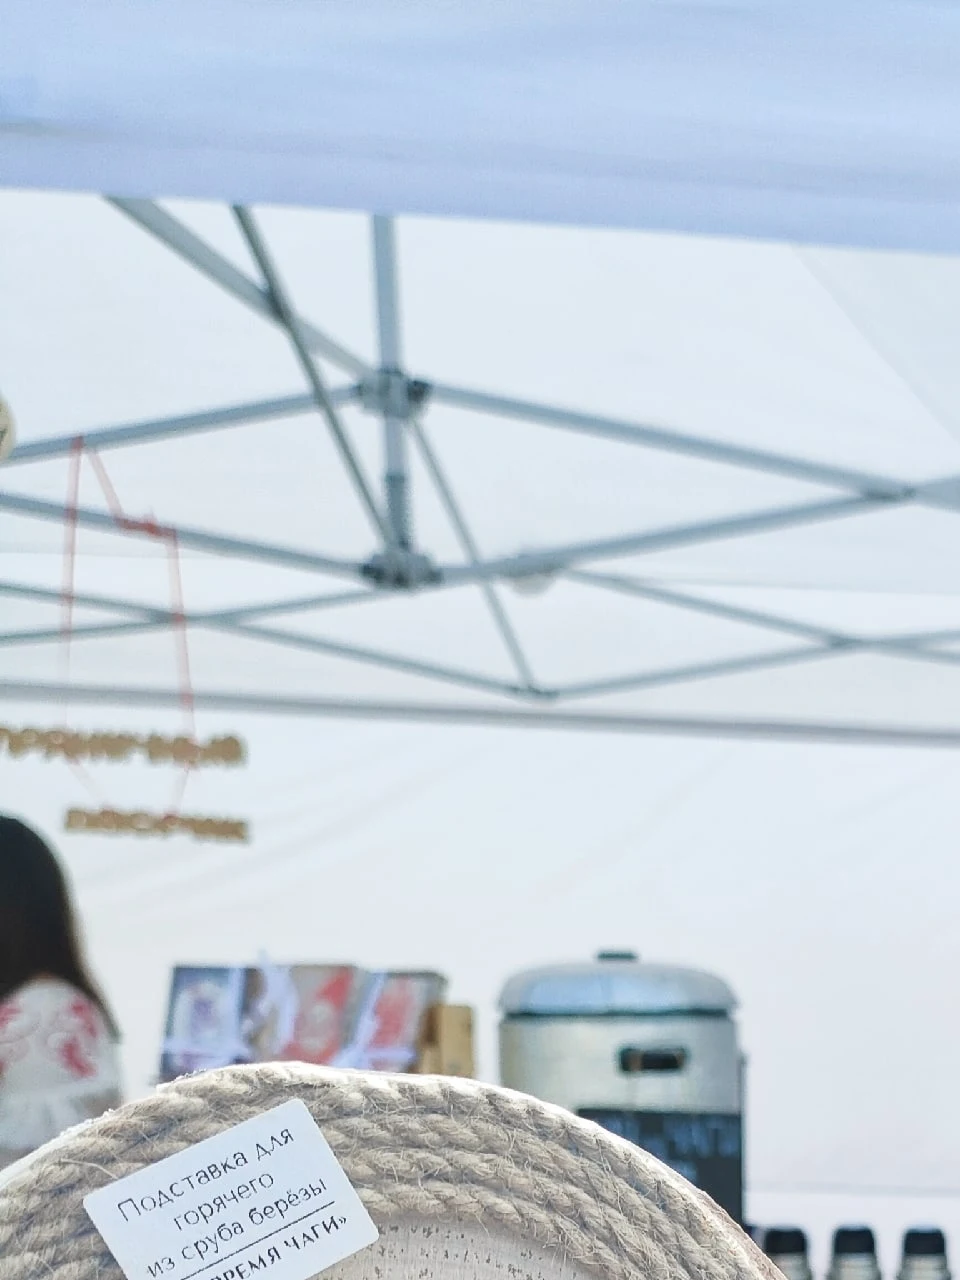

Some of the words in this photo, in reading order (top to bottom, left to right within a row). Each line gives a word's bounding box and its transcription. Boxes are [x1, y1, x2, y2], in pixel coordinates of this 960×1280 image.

[118, 1151, 248, 1222] Подставка
[255, 1128, 294, 1161] для
[173, 1173, 274, 1232] горячего
[147, 1256, 176, 1278] из
[181, 1218, 244, 1261] сруба
[248, 1178, 328, 1227] берёзы
[283, 1215, 347, 1251] ЧАГИ»
